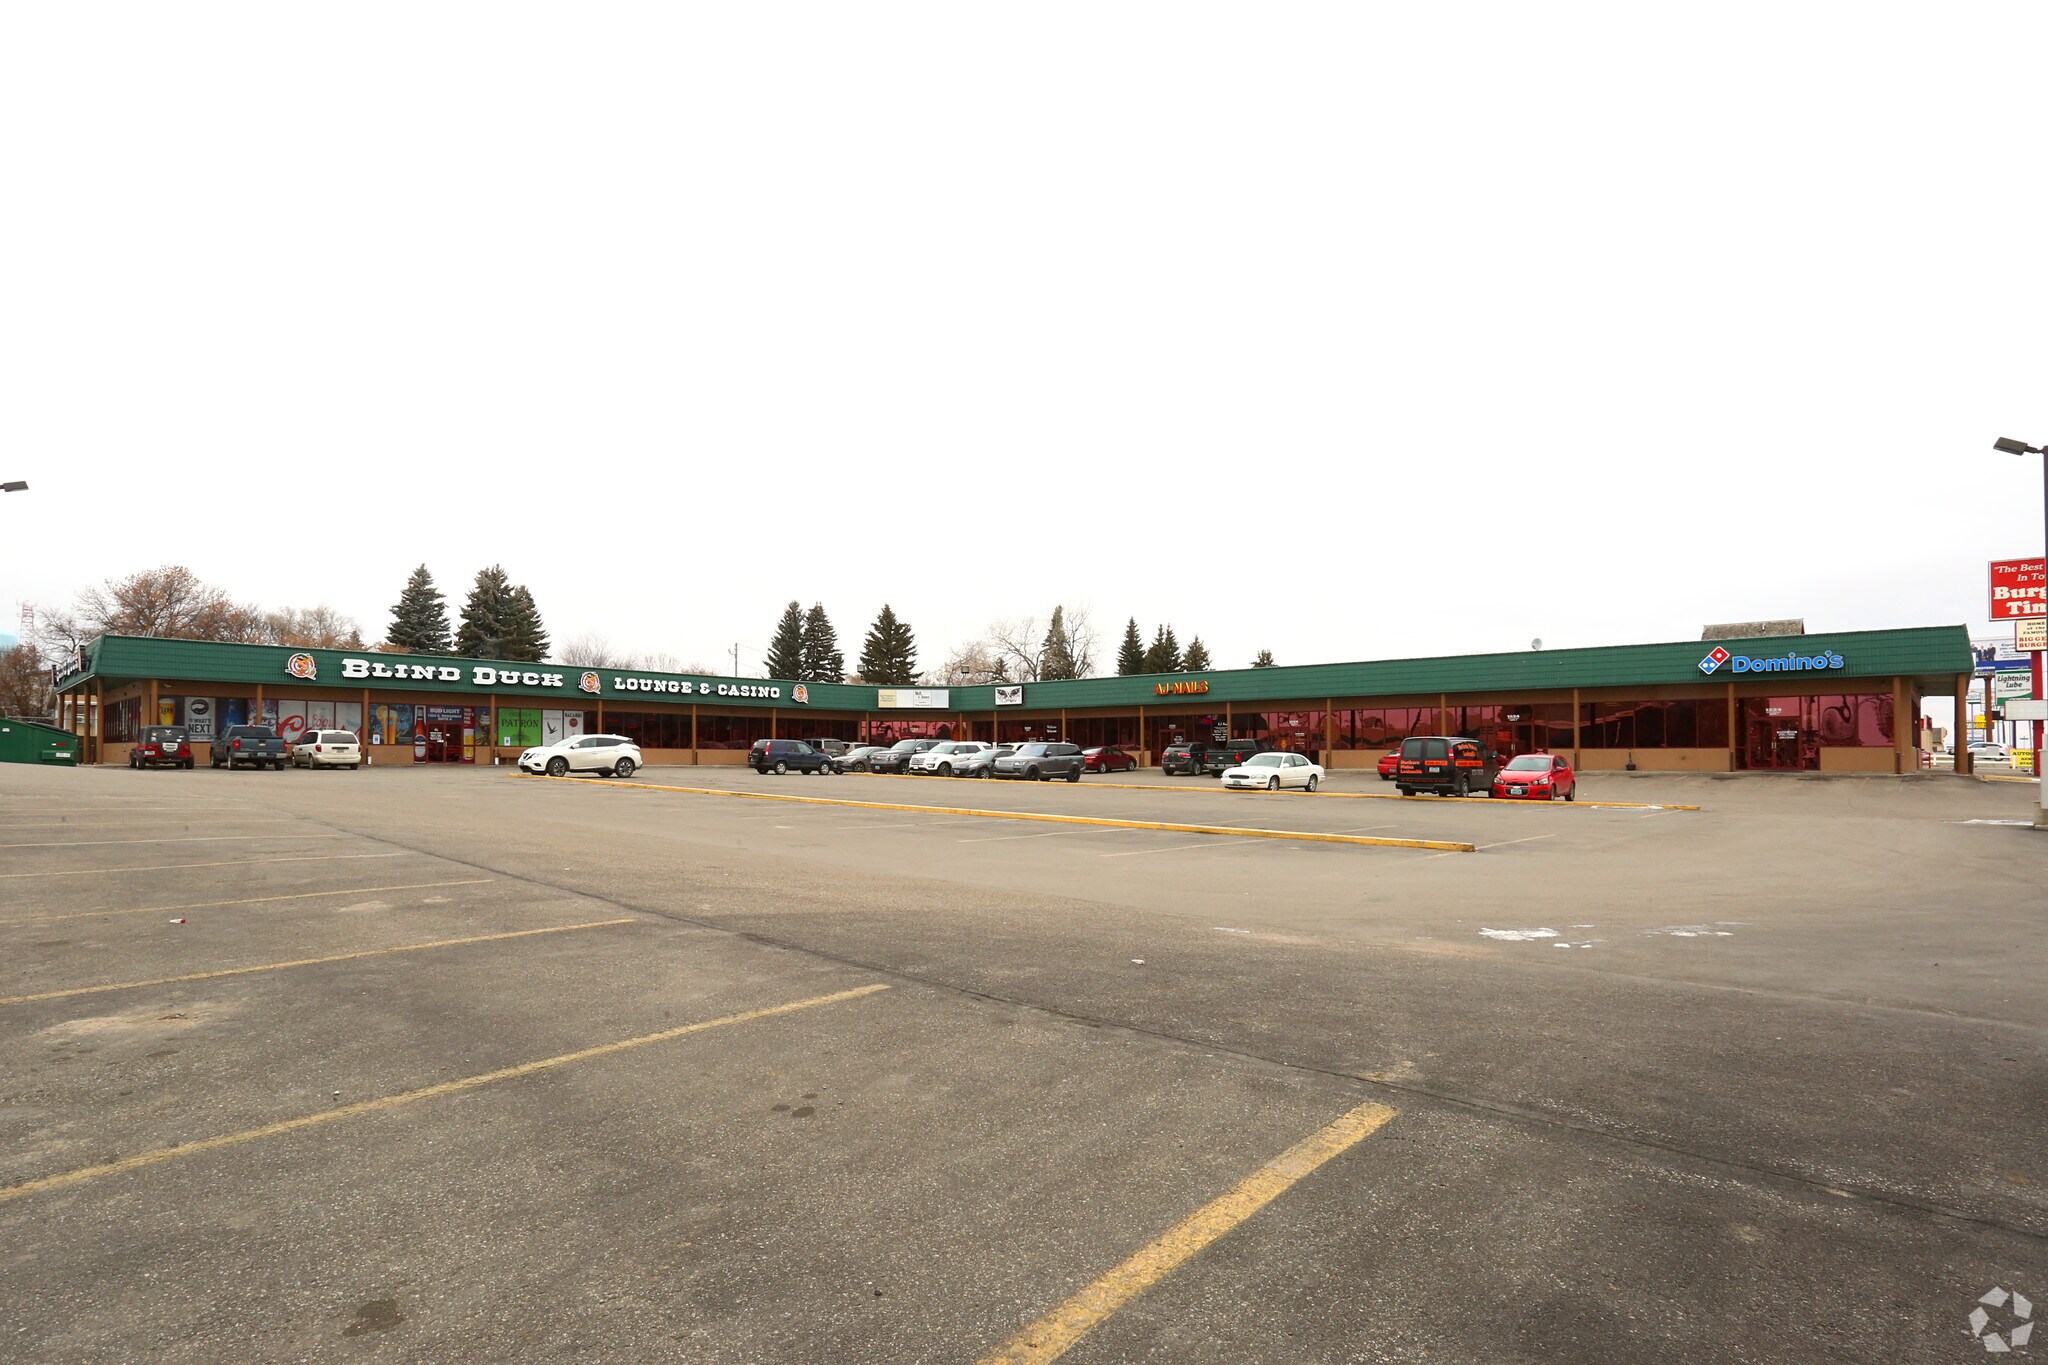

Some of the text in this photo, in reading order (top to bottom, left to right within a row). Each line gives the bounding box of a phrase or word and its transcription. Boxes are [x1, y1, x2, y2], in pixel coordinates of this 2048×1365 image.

[2020, 563, 2043, 572] Best
[2017, 574, 2028, 582] In
[1732, 650, 1844, 673] Domino's
[1997, 675, 2031, 683] Lightning
[614, 677, 780, 699] LOUNGE & CASINO
[1154, 681, 1209, 695] AJ NAILS
[188, 724, 212, 733] NEXT
